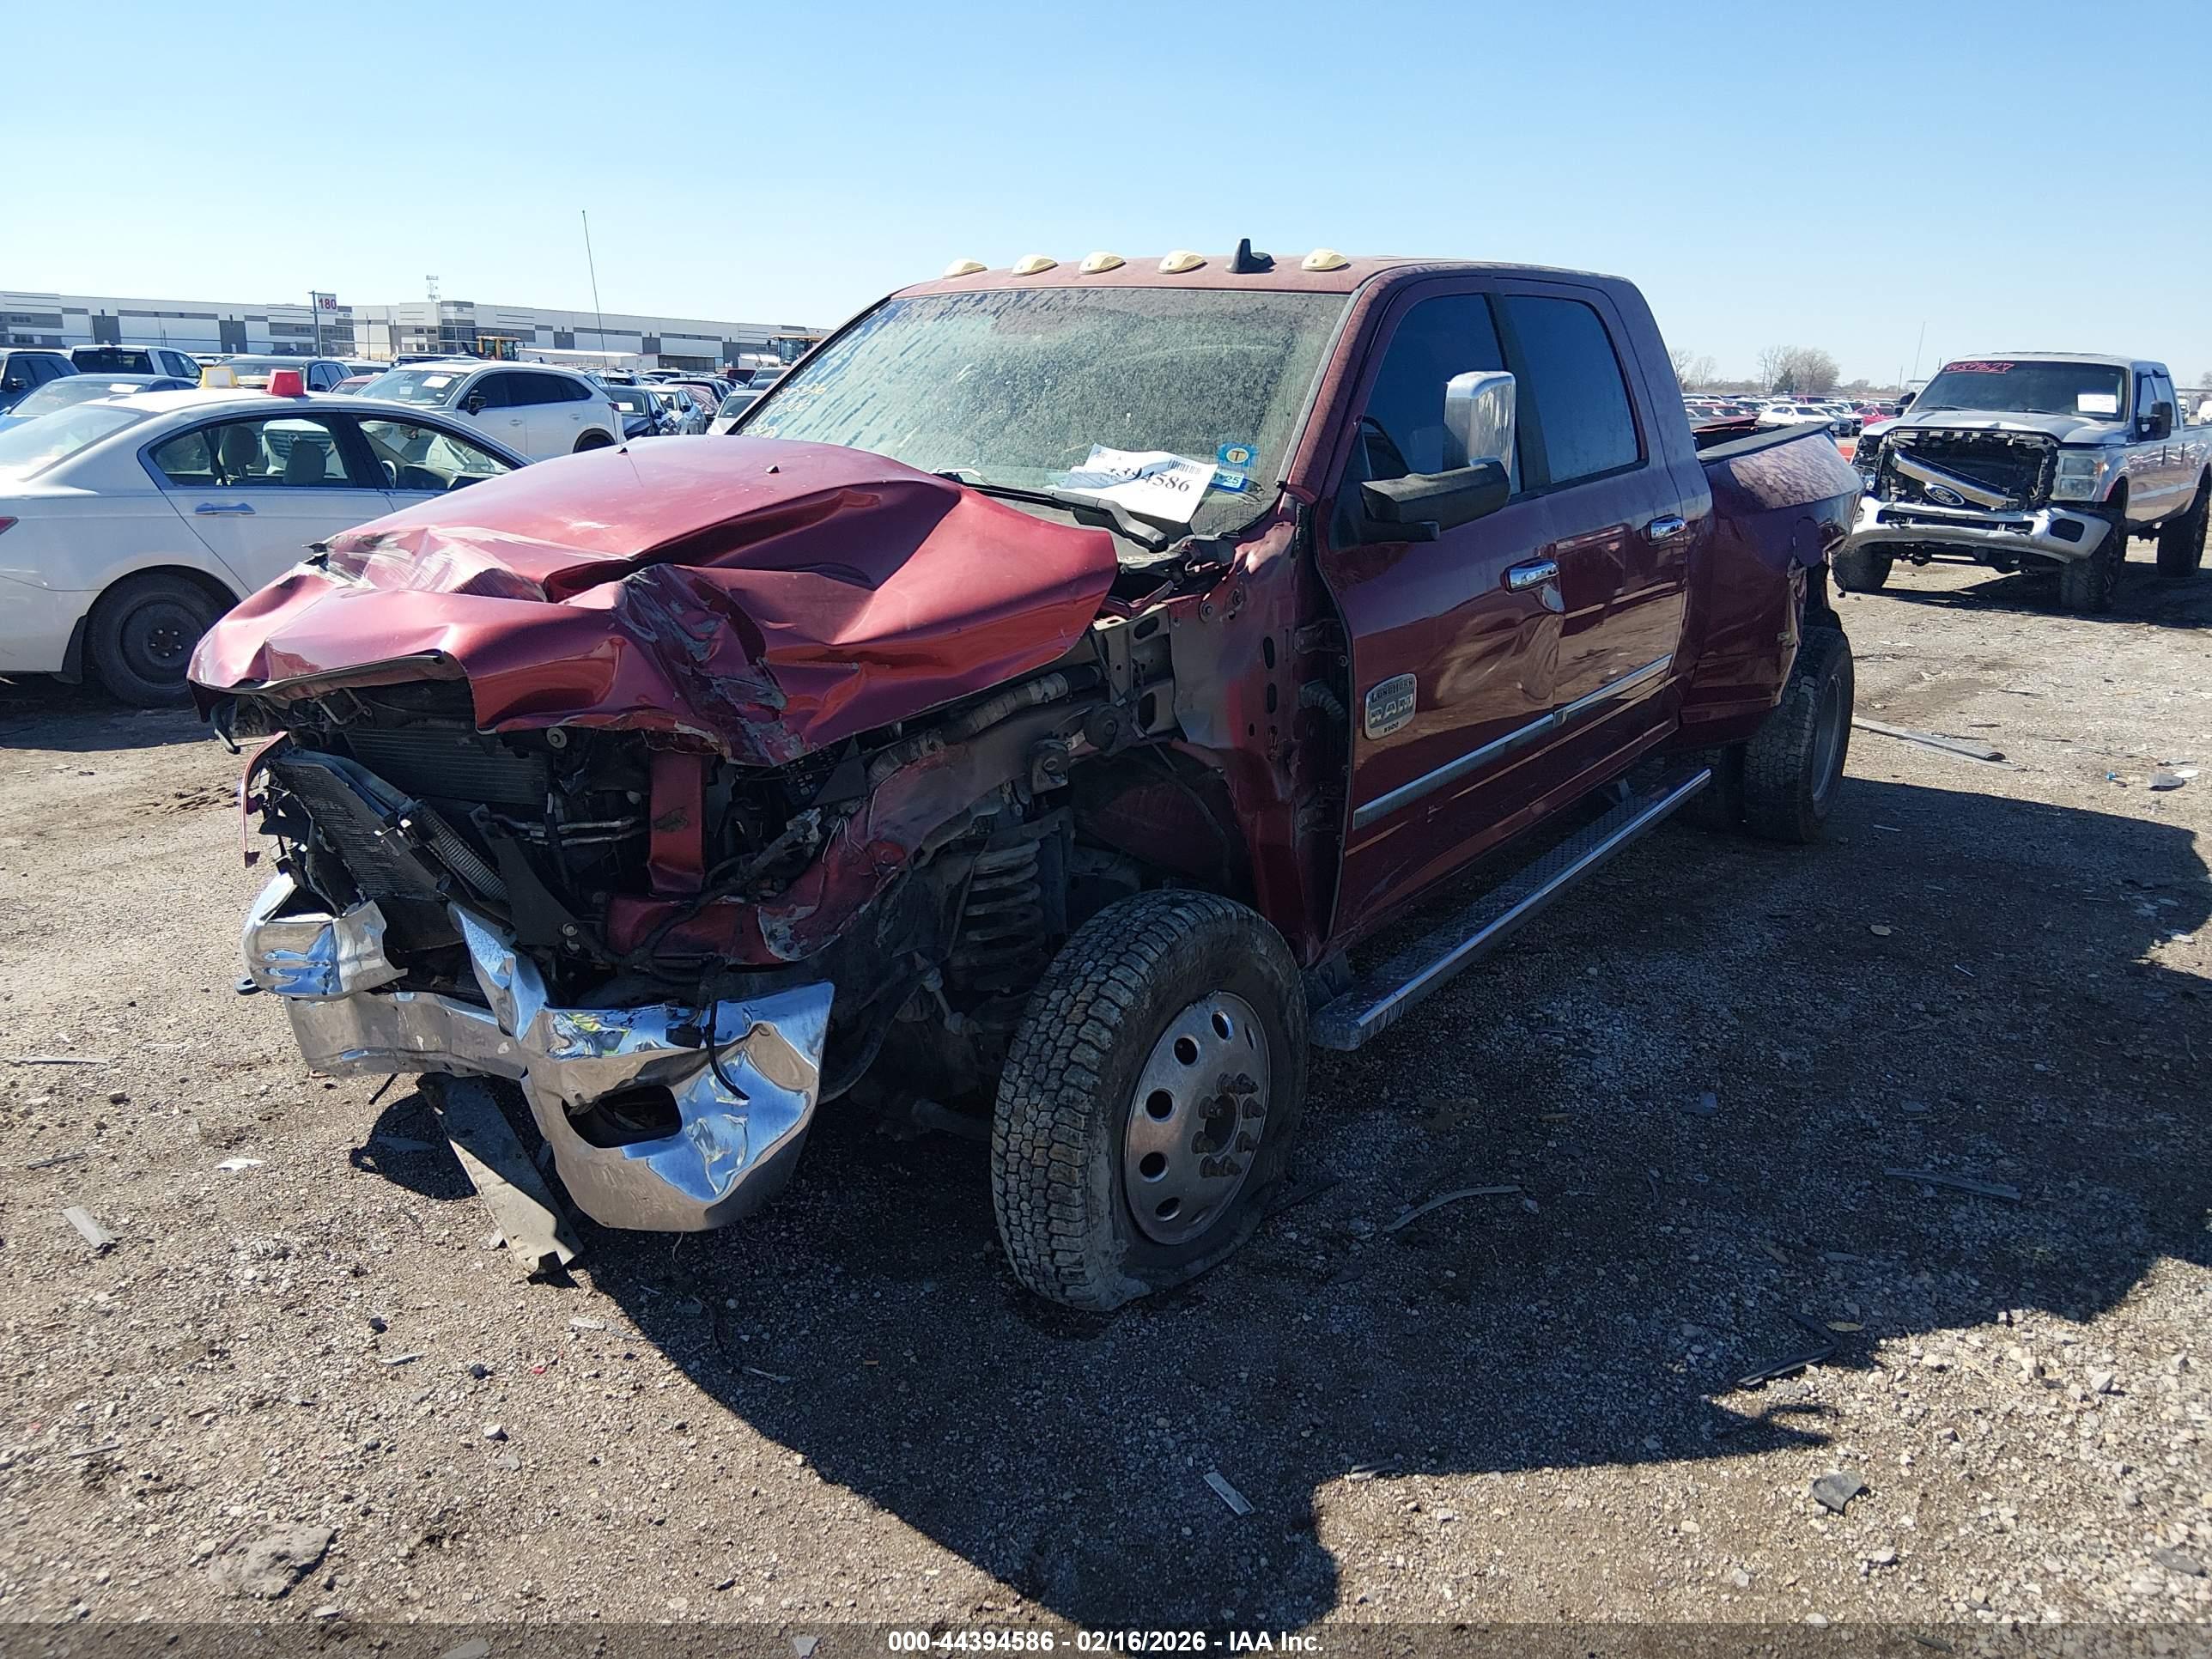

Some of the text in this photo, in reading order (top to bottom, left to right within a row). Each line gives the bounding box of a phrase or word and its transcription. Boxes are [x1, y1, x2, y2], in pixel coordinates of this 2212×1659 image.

[319, 298, 337, 310] 180
[1931, 489, 1955, 503] Ford
[1370, 694, 1414, 723] RAM
